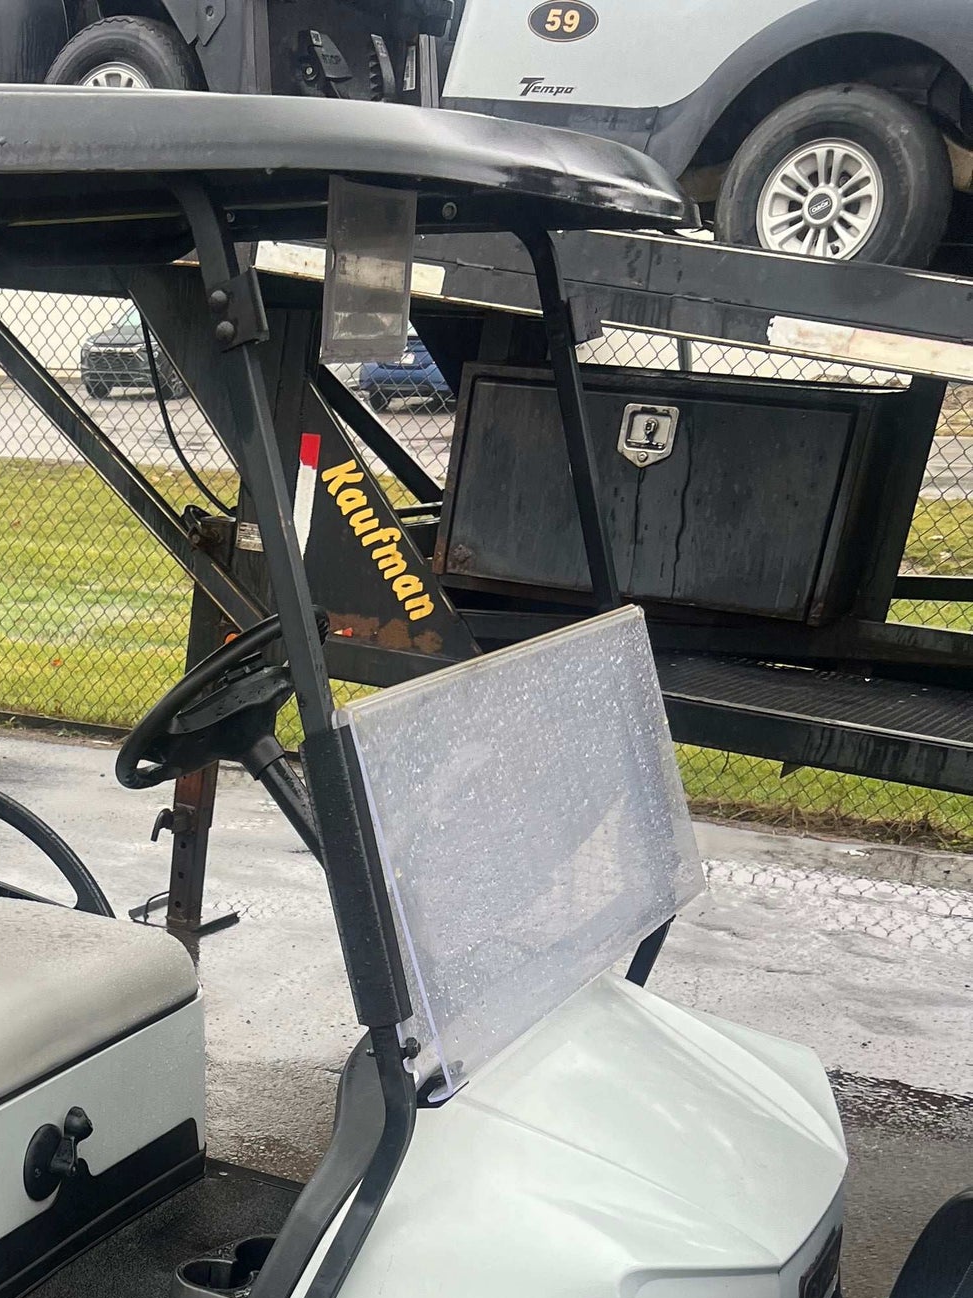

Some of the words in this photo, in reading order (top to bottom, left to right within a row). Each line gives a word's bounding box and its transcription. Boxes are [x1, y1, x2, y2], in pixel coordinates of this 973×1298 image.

[545, 8, 580, 32] 59
[519, 77, 574, 96] Tempo
[321, 459, 434, 621] Kaufman
